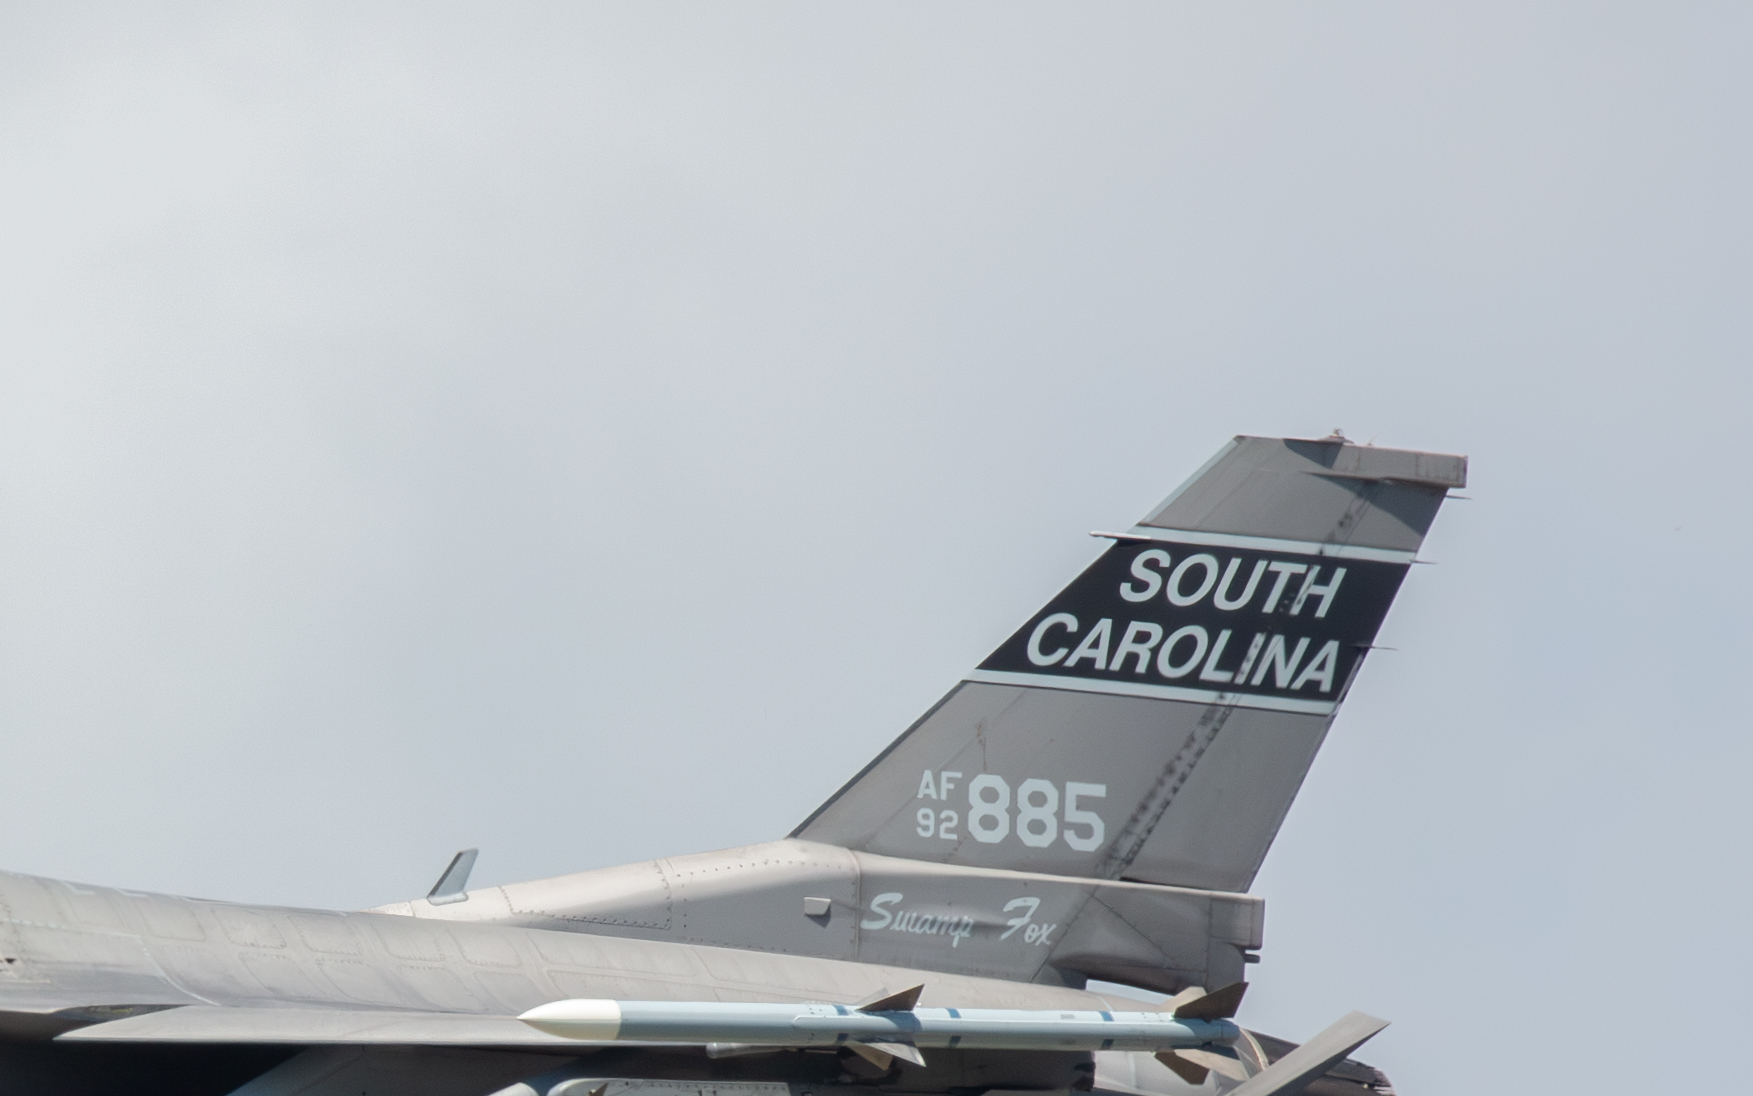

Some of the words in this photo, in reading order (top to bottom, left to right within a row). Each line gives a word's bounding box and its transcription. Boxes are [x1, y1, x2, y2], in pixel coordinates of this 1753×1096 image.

[1119, 548, 1346, 619] SOUTH
[1026, 611, 1340, 693] CAROLINA
[916, 769, 963, 801] AF
[967, 774, 1107, 852] 885
[916, 807, 959, 840] 92
[860, 892, 974, 949] Swamp
[998, 896, 1057, 946] Fox
